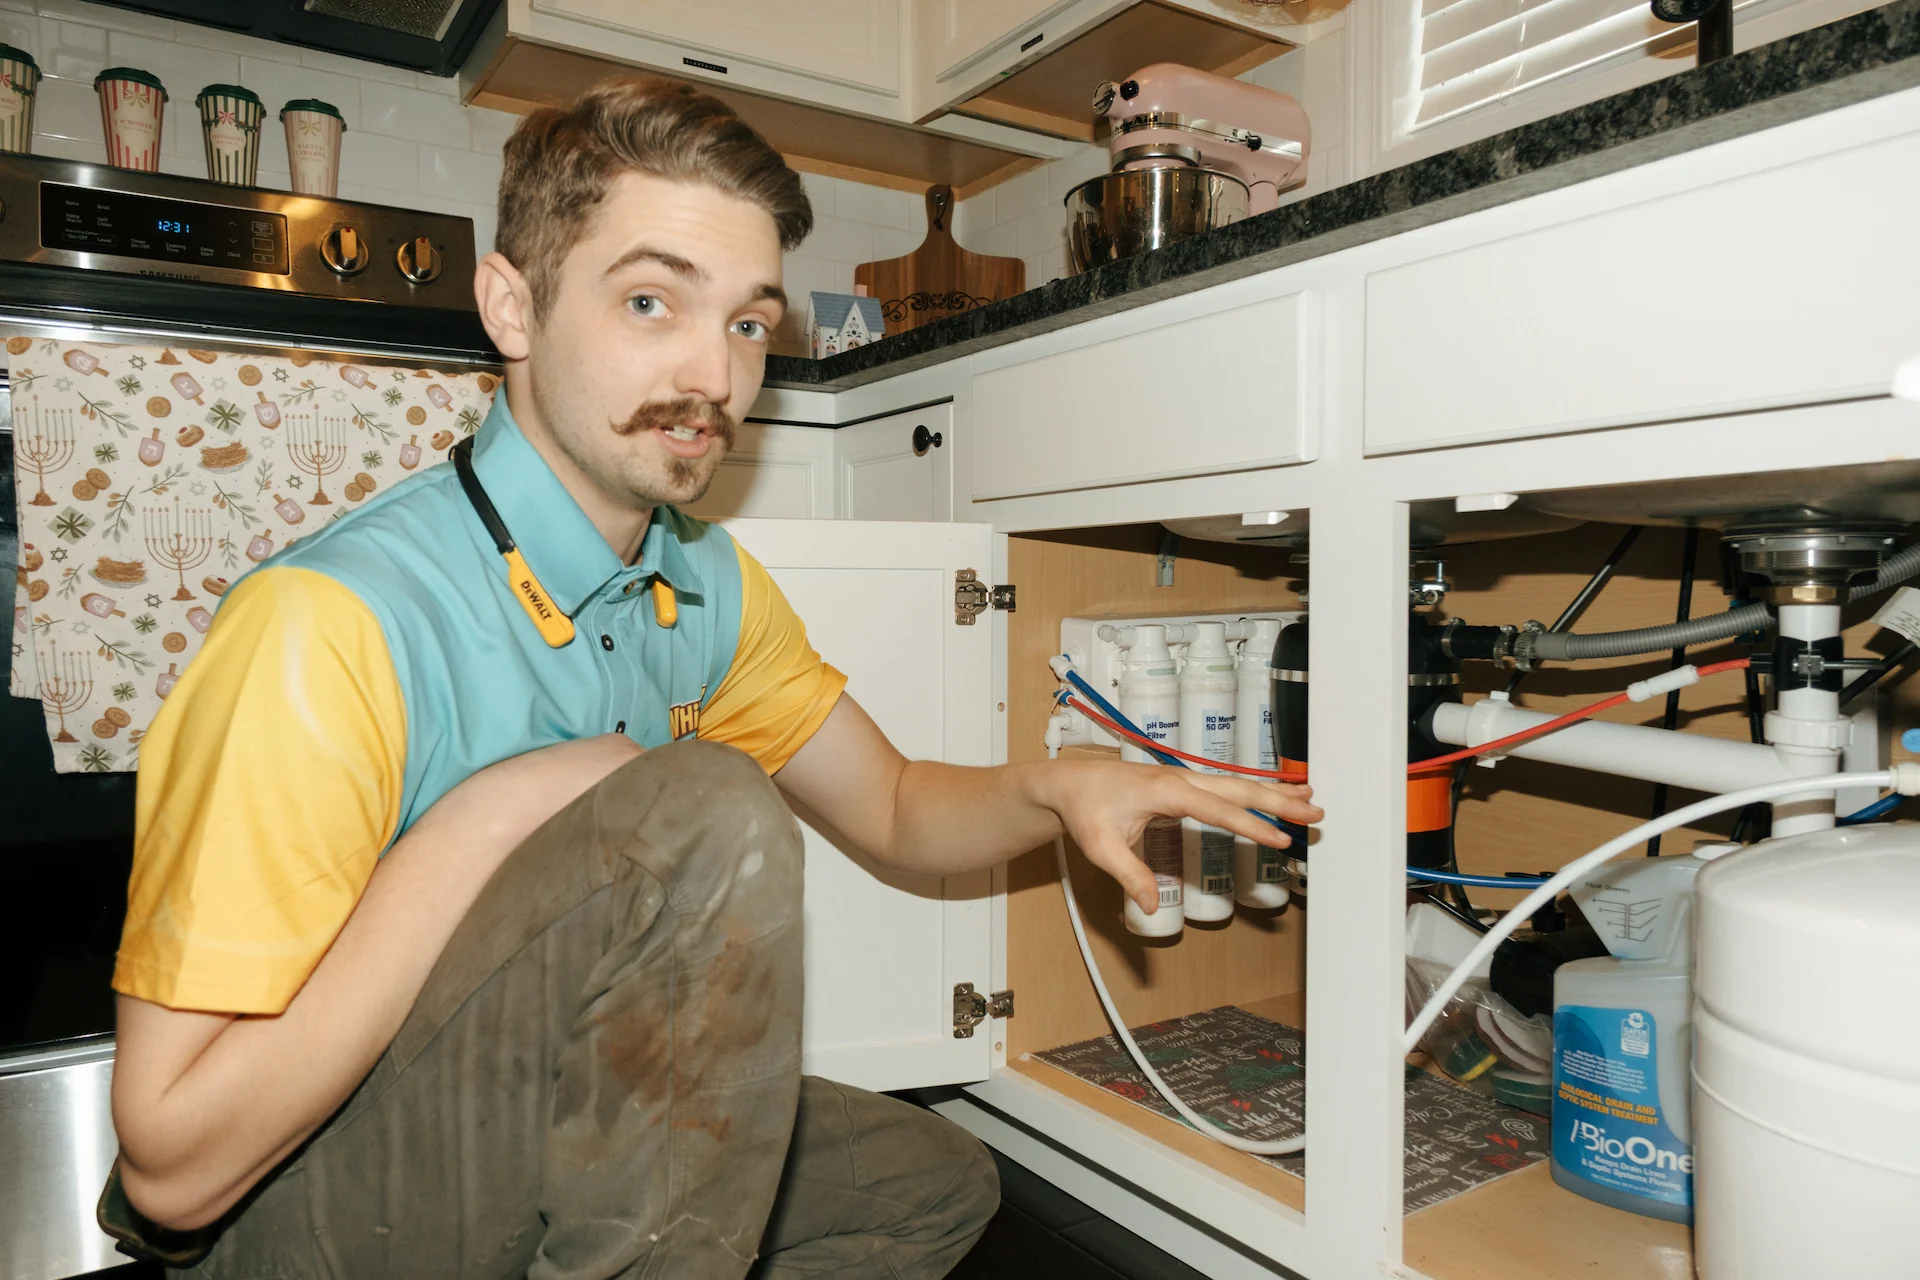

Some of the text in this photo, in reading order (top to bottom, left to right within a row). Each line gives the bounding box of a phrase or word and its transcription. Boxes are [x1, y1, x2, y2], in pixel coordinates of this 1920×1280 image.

[158, 220, 190, 234] 12:31
[165, 242, 187, 251] Cooking
[1146, 722, 1157, 731] pH
[1206, 723, 1216, 731] 50
[1605, 885, 1630, 893] Ounces
[1558, 1089, 1660, 1126] SEPTIC SYSTEM TREATMENT
[1560, 1081, 1656, 1116] BIOLOGICAL DRAIN AND
[1576, 1119, 1693, 1174] BioOne
[1588, 1160, 1612, 1175] Septic
[1612, 1168, 1648, 1183] Systems
[1648, 1177, 1682, 1192] Flowing
[1594, 1155, 1667, 1180] Keeps Drain Lines
